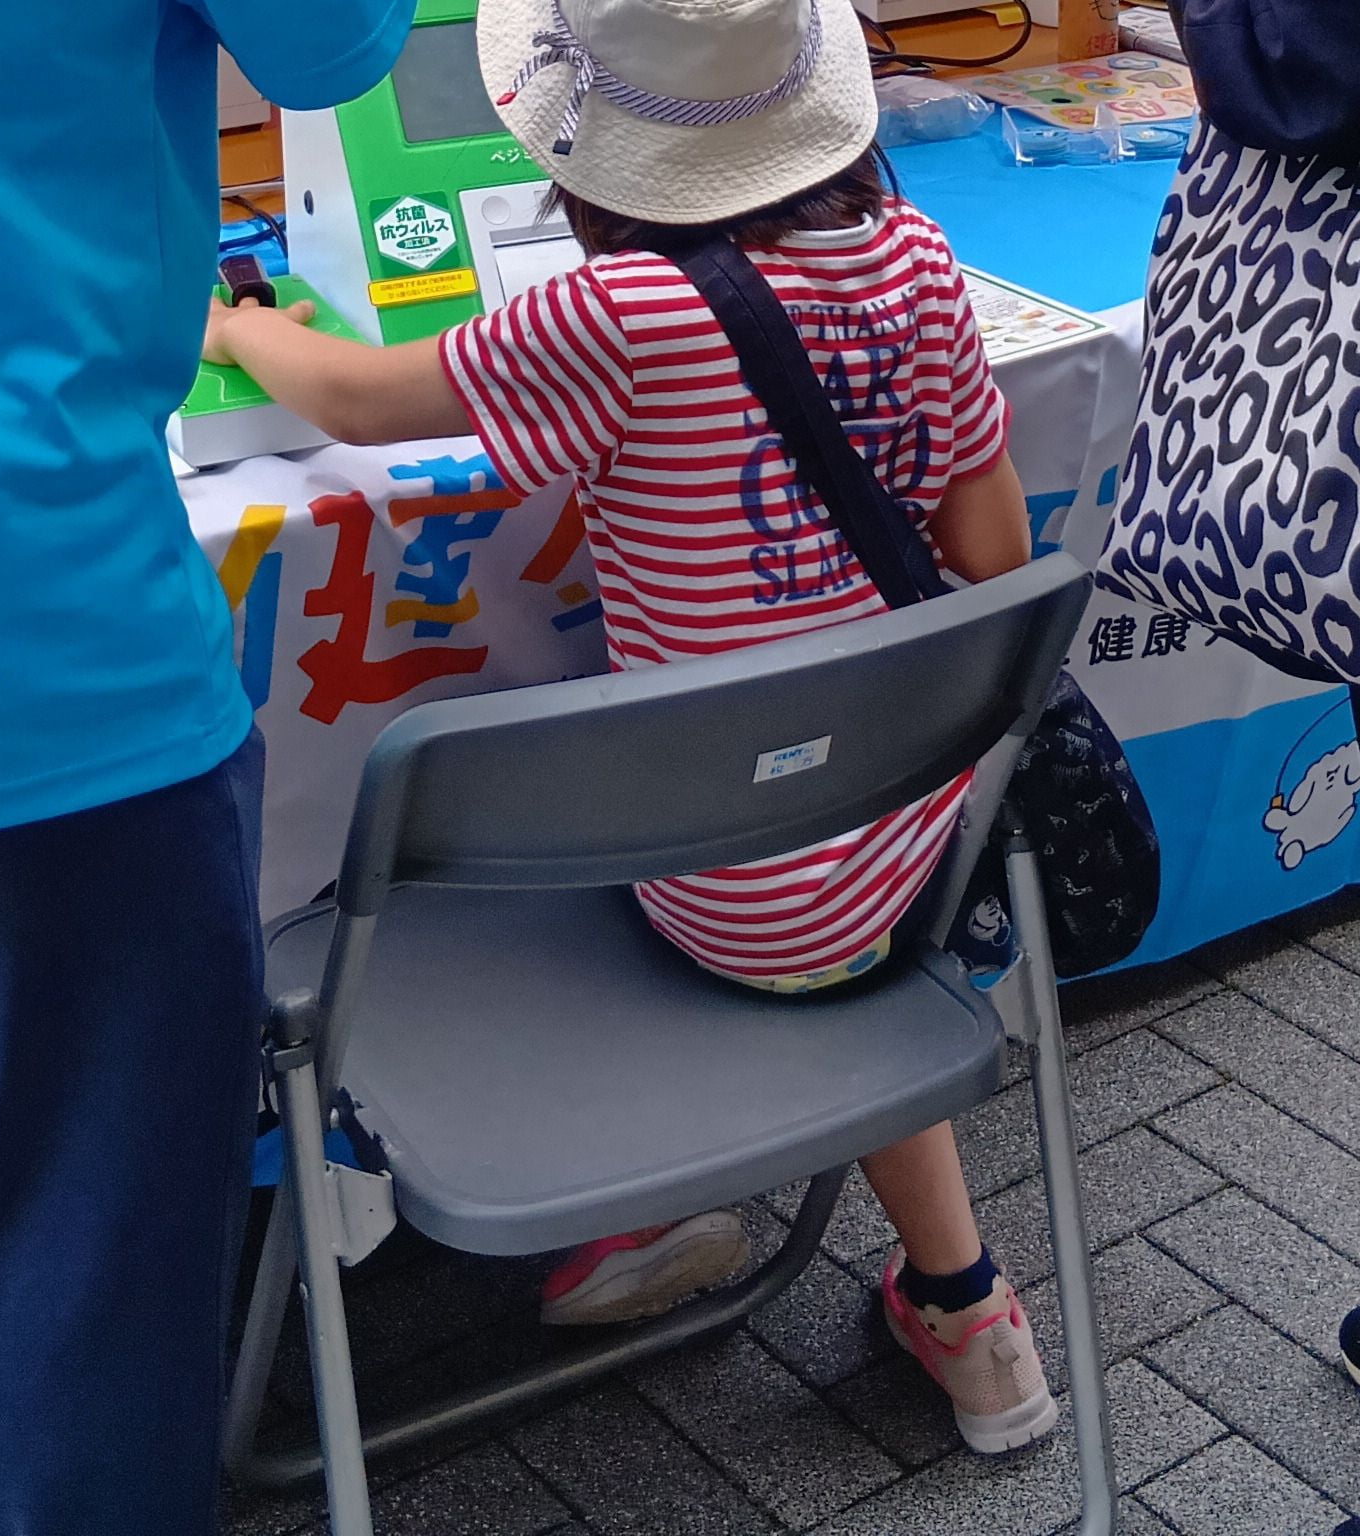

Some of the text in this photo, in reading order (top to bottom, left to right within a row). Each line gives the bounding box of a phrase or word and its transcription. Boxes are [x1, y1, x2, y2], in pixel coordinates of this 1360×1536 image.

[395, 205, 427, 223] 抗菌
[380, 217, 450, 241] 抗ウィルス
